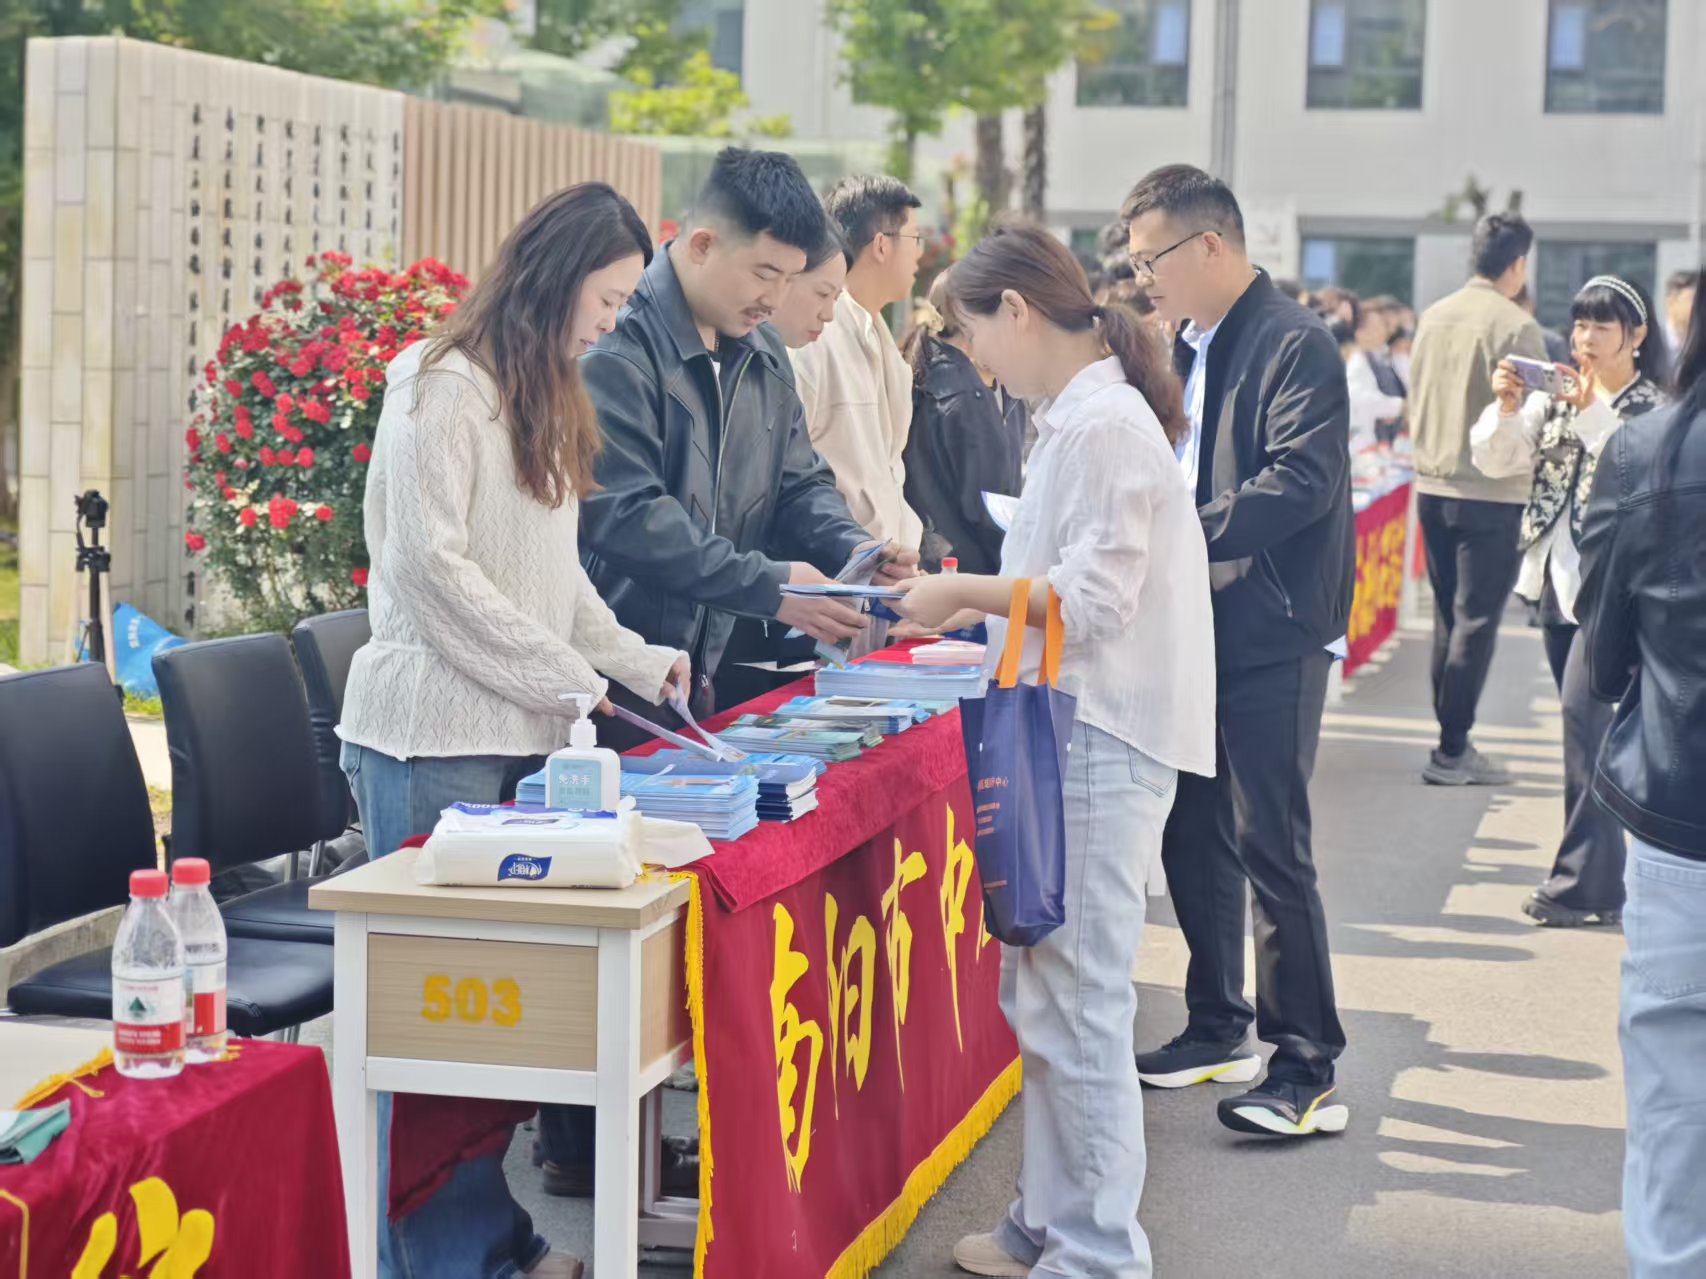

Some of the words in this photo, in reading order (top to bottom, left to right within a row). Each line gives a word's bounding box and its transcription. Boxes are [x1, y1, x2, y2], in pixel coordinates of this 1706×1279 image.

[421, 975, 523, 1026] 503
[770, 802, 992, 1193] 南阳市中
